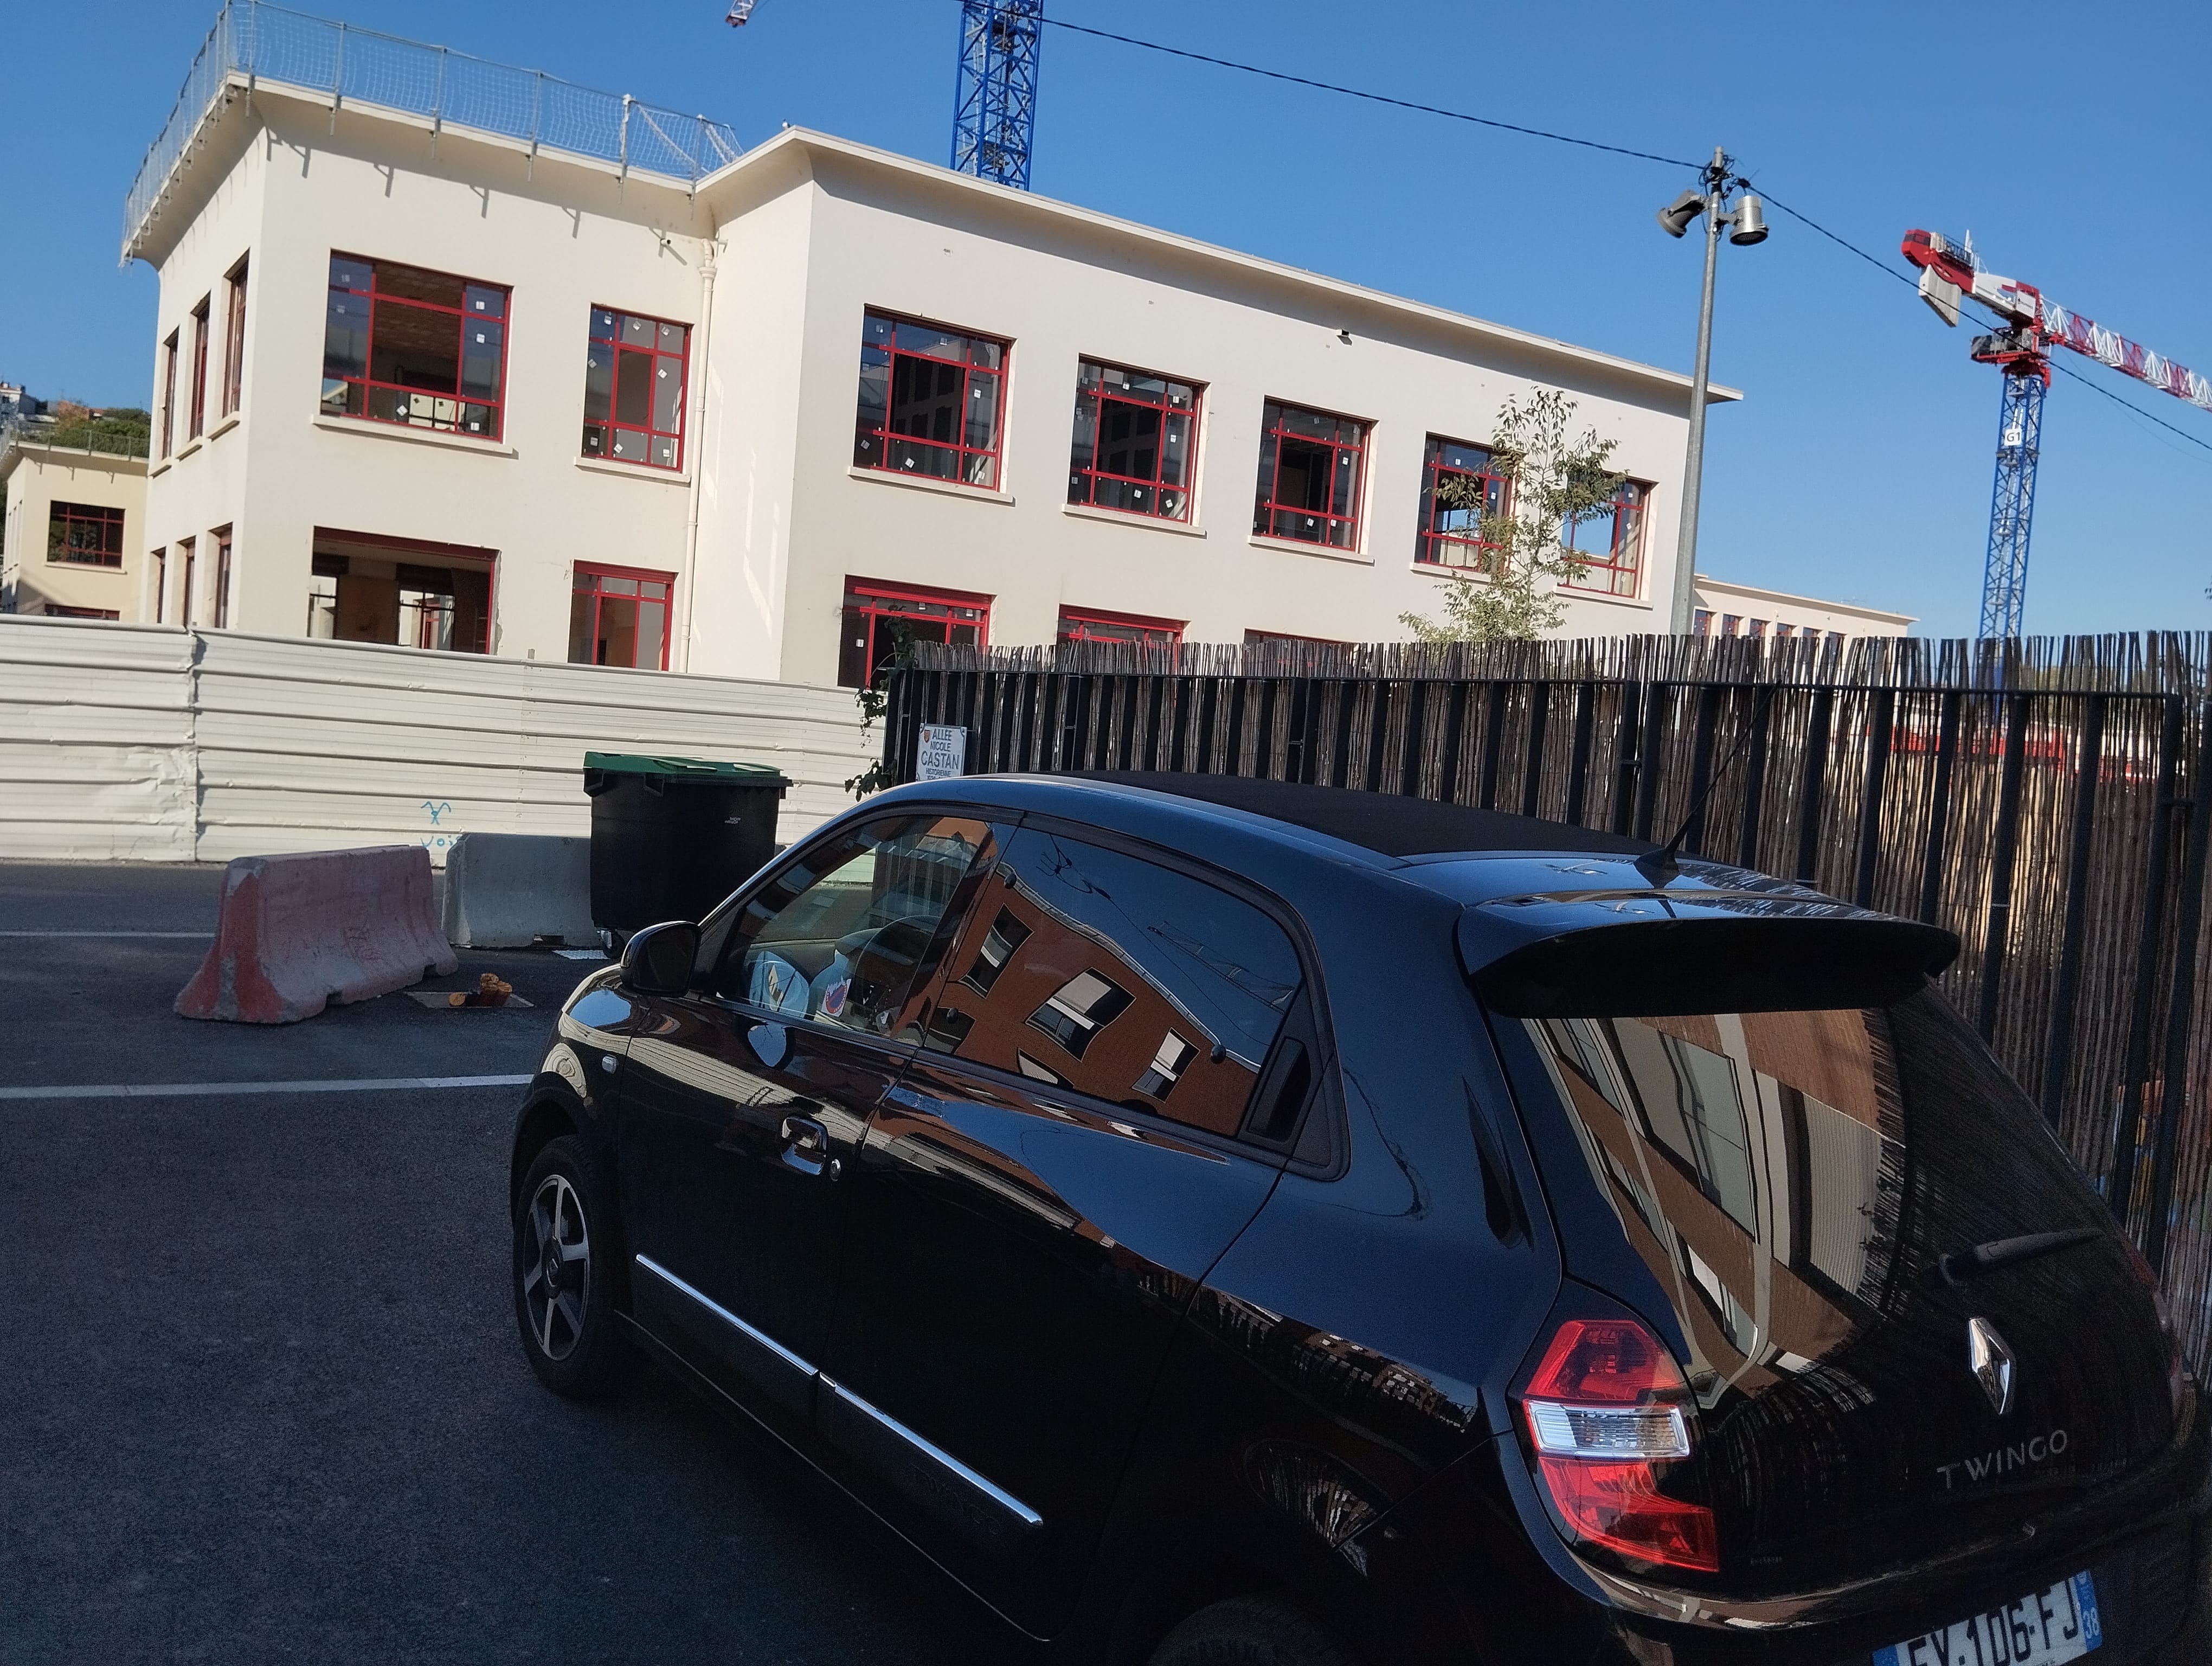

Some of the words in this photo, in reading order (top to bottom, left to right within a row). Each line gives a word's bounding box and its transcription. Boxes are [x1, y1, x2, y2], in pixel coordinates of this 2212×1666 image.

[2007, 433, 2020, 441] G1
[930, 741, 951, 752] NICOLE
[922, 751, 959, 770] CASTAN
[1937, 1430, 2067, 1489] TWINGO
[2083, 1607, 2099, 1639] 38
